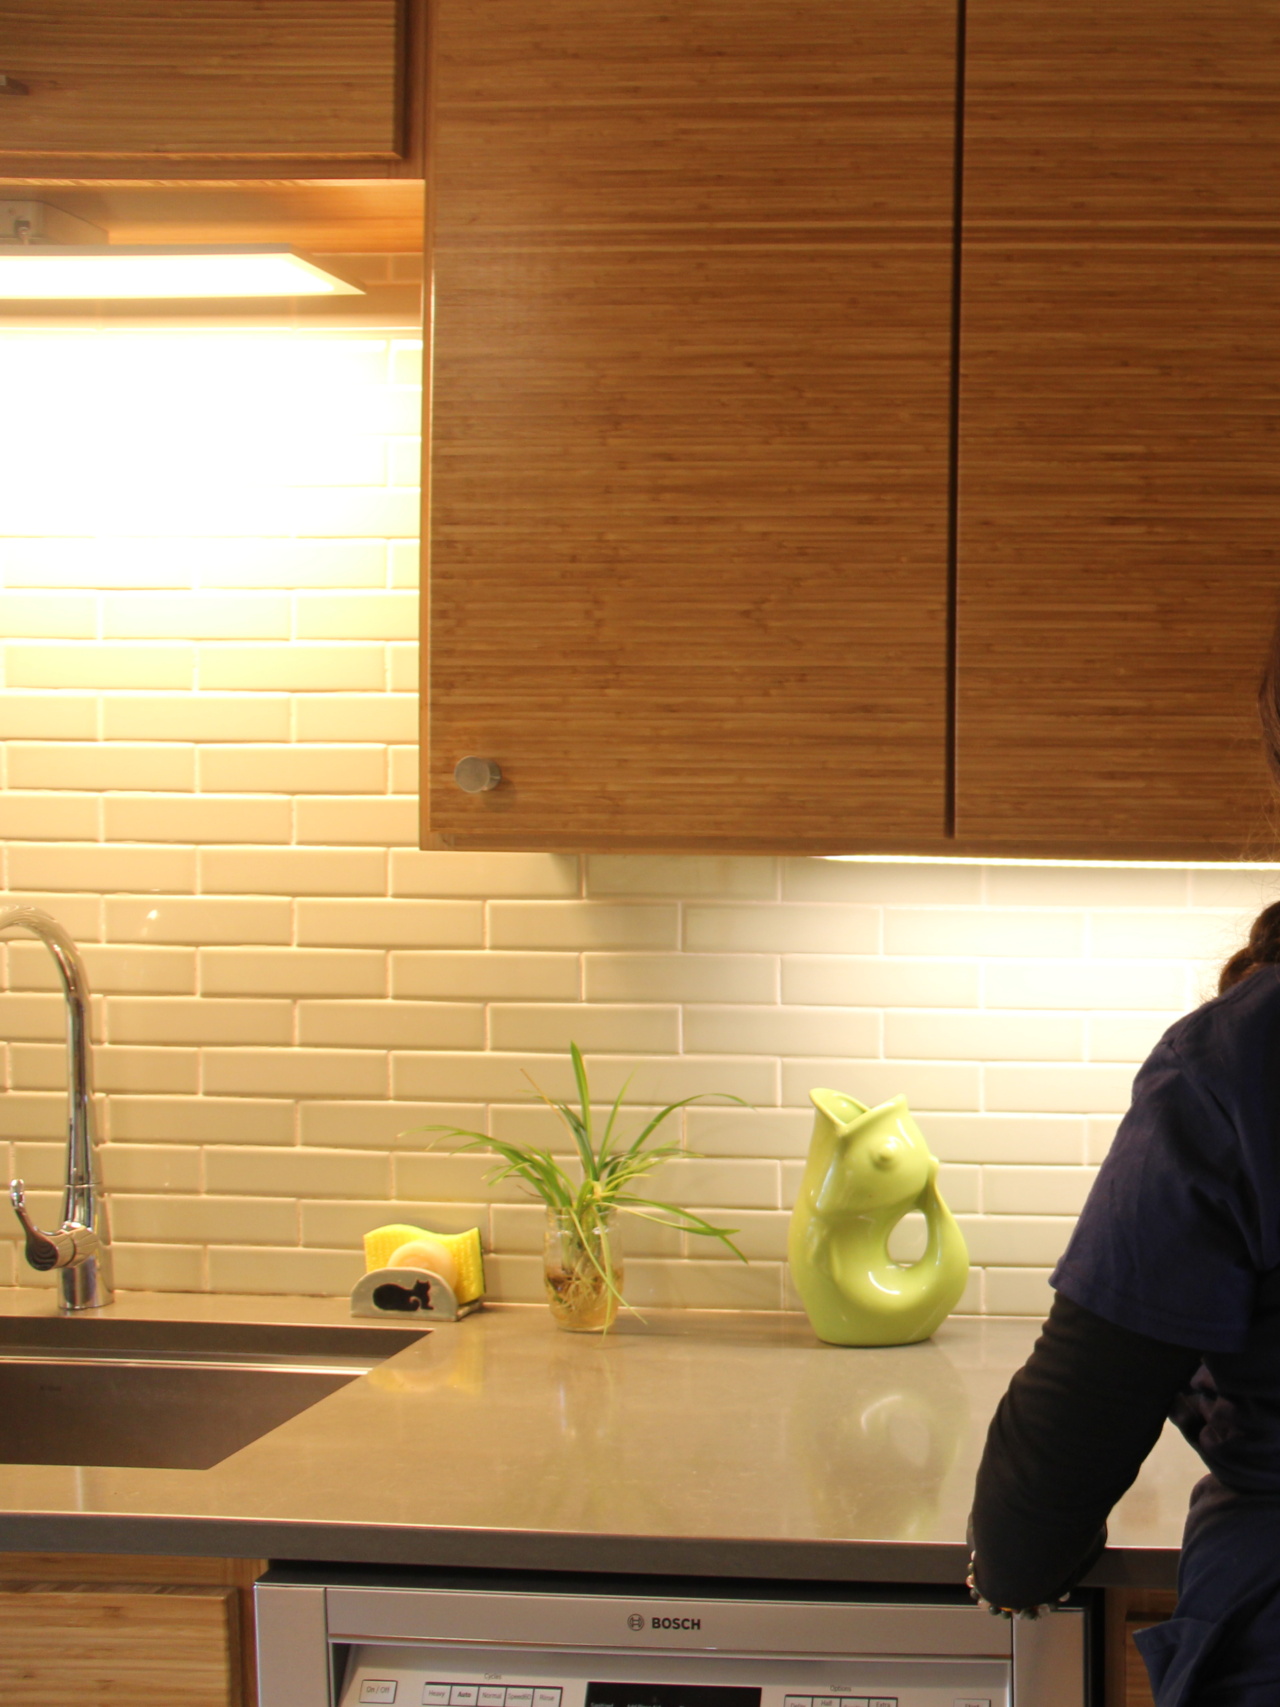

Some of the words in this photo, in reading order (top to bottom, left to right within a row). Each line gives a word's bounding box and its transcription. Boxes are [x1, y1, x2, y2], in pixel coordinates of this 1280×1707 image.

[651, 1617, 701, 1630] BOSCH
[484, 1673, 502, 1681] Cycles
[829, 1684, 852, 1693] Options
[428, 1690, 446, 1698] Heavy
